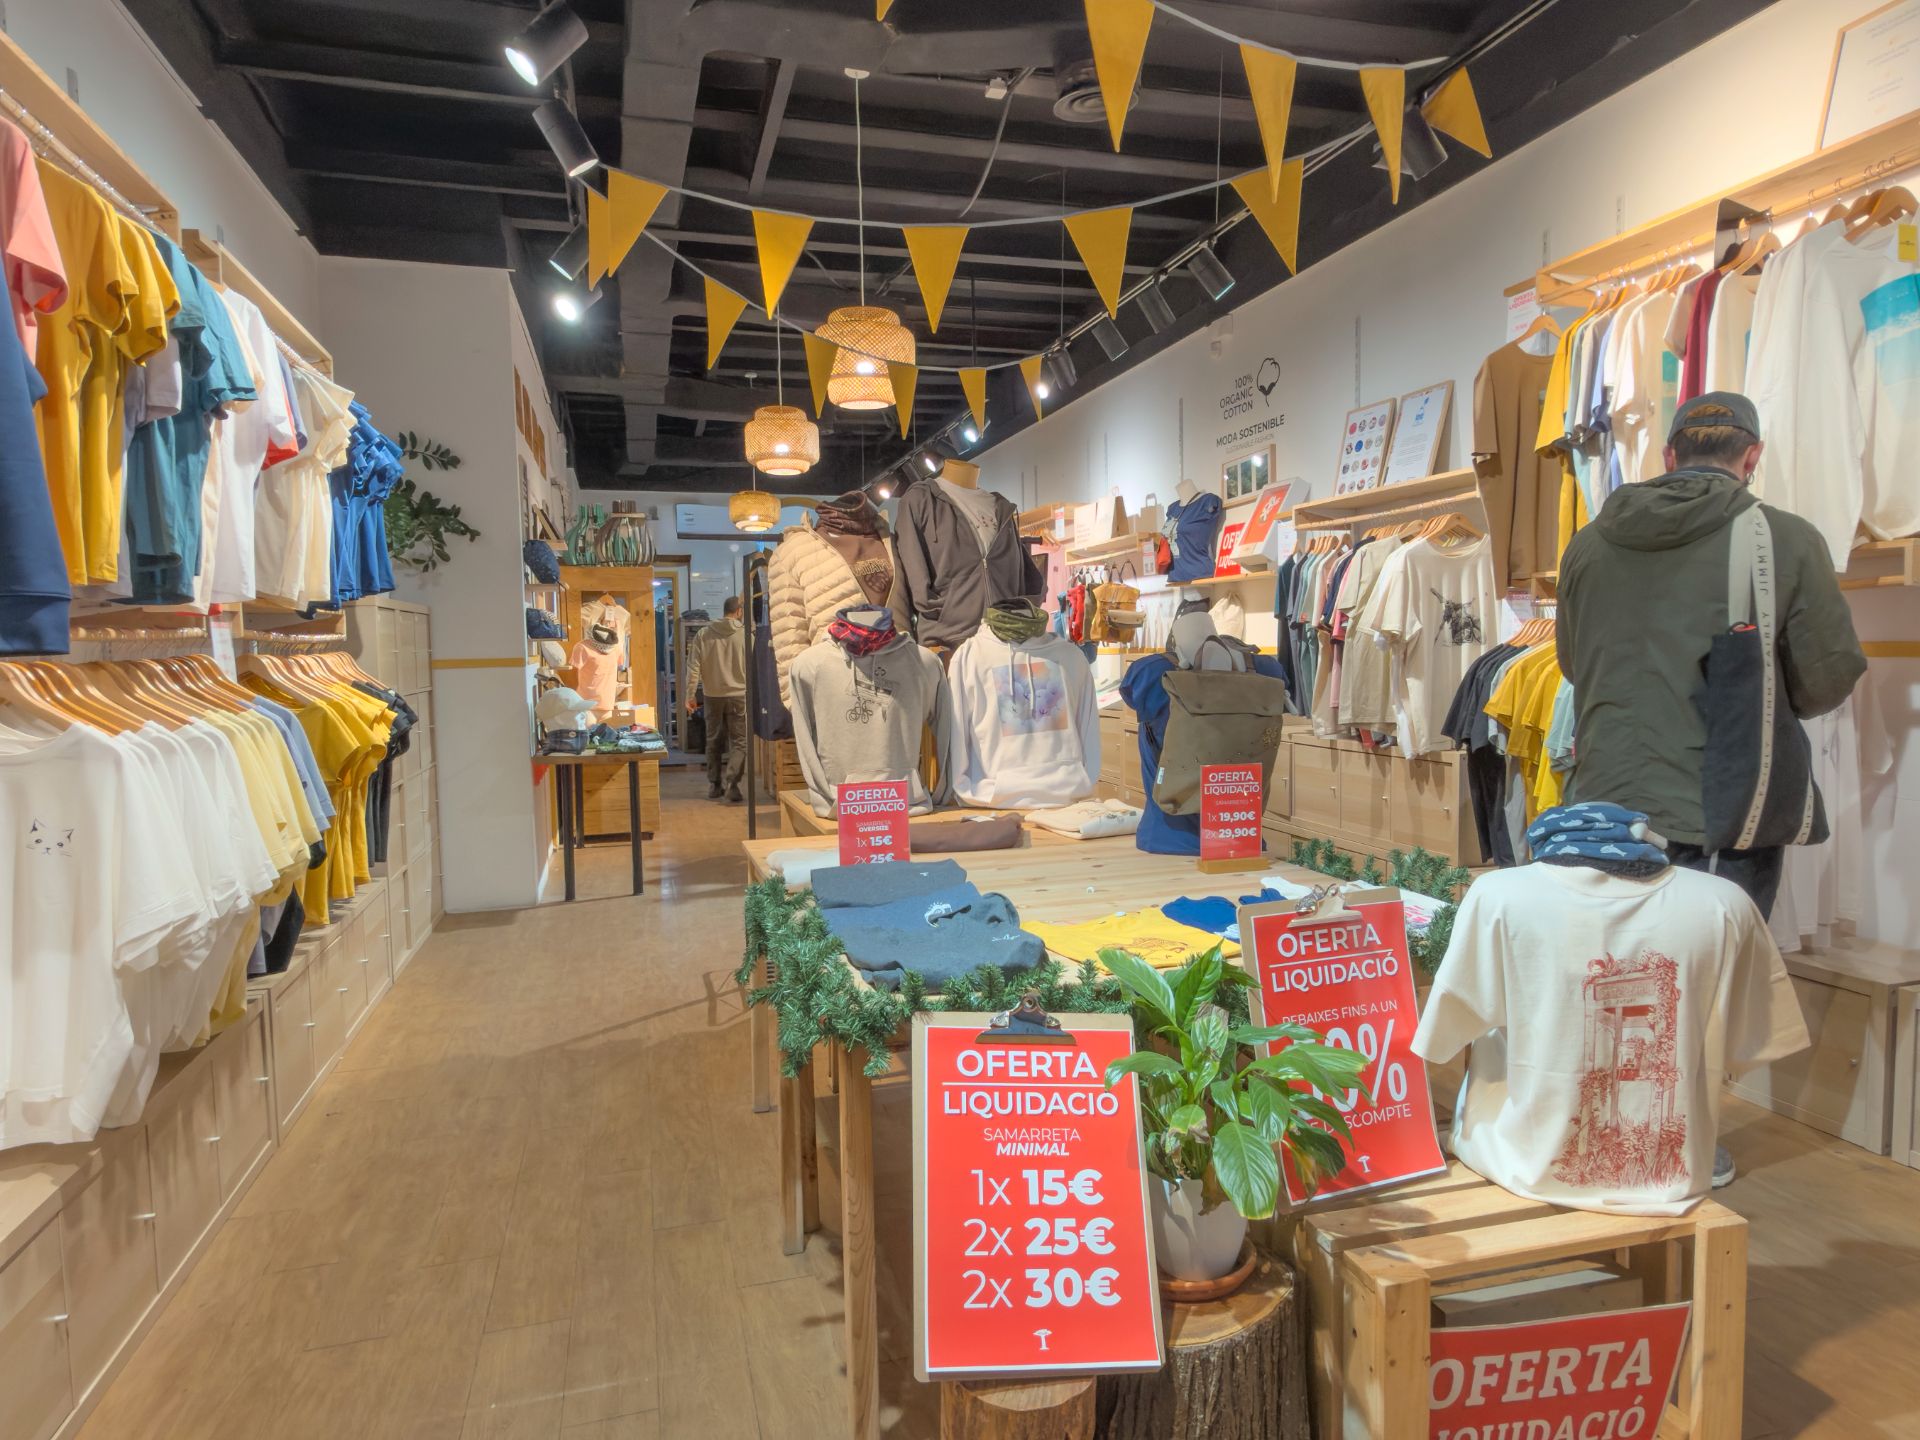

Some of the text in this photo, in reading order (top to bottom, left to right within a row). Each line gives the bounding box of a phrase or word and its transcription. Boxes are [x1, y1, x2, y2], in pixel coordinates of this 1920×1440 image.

[1235, 375, 1254, 389] 100%
[1219, 386, 1254, 409] ORGANIC
[1223, 400, 1253, 420] COTTON
[1216, 414, 1285, 447] MODA SOSTENIBLE
[1756, 544, 1769, 595] JIMMY
[1208, 771, 1254, 782] OFERTA
[845, 788, 898, 801] OFERTA
[1207, 811, 1256, 823] 1x 19,90€
[856, 835, 893, 848] 1x 15€
[1218, 827, 1257, 839] 29,90€
[869, 852, 895, 864] 25€
[1277, 923, 1382, 958] OFERTA
[1271, 951, 1399, 993] LIQUIDACIÓ
[1341, 1003, 1368, 1019] FINS
[1369, 1002, 1379, 1014] A
[1380, 999, 1398, 1012] UN
[956, 1049, 1098, 1078] OFERTA
[983, 1127, 1081, 1142] SAMARRETA
[996, 1142, 1070, 1157] MINIMAL
[970, 1168, 1105, 1206] 1x 15€
[963, 1216, 1117, 1256] 2x 25€
[962, 1266, 1122, 1310] 2x 30€
[1430, 1338, 1653, 1410] OFERTA
